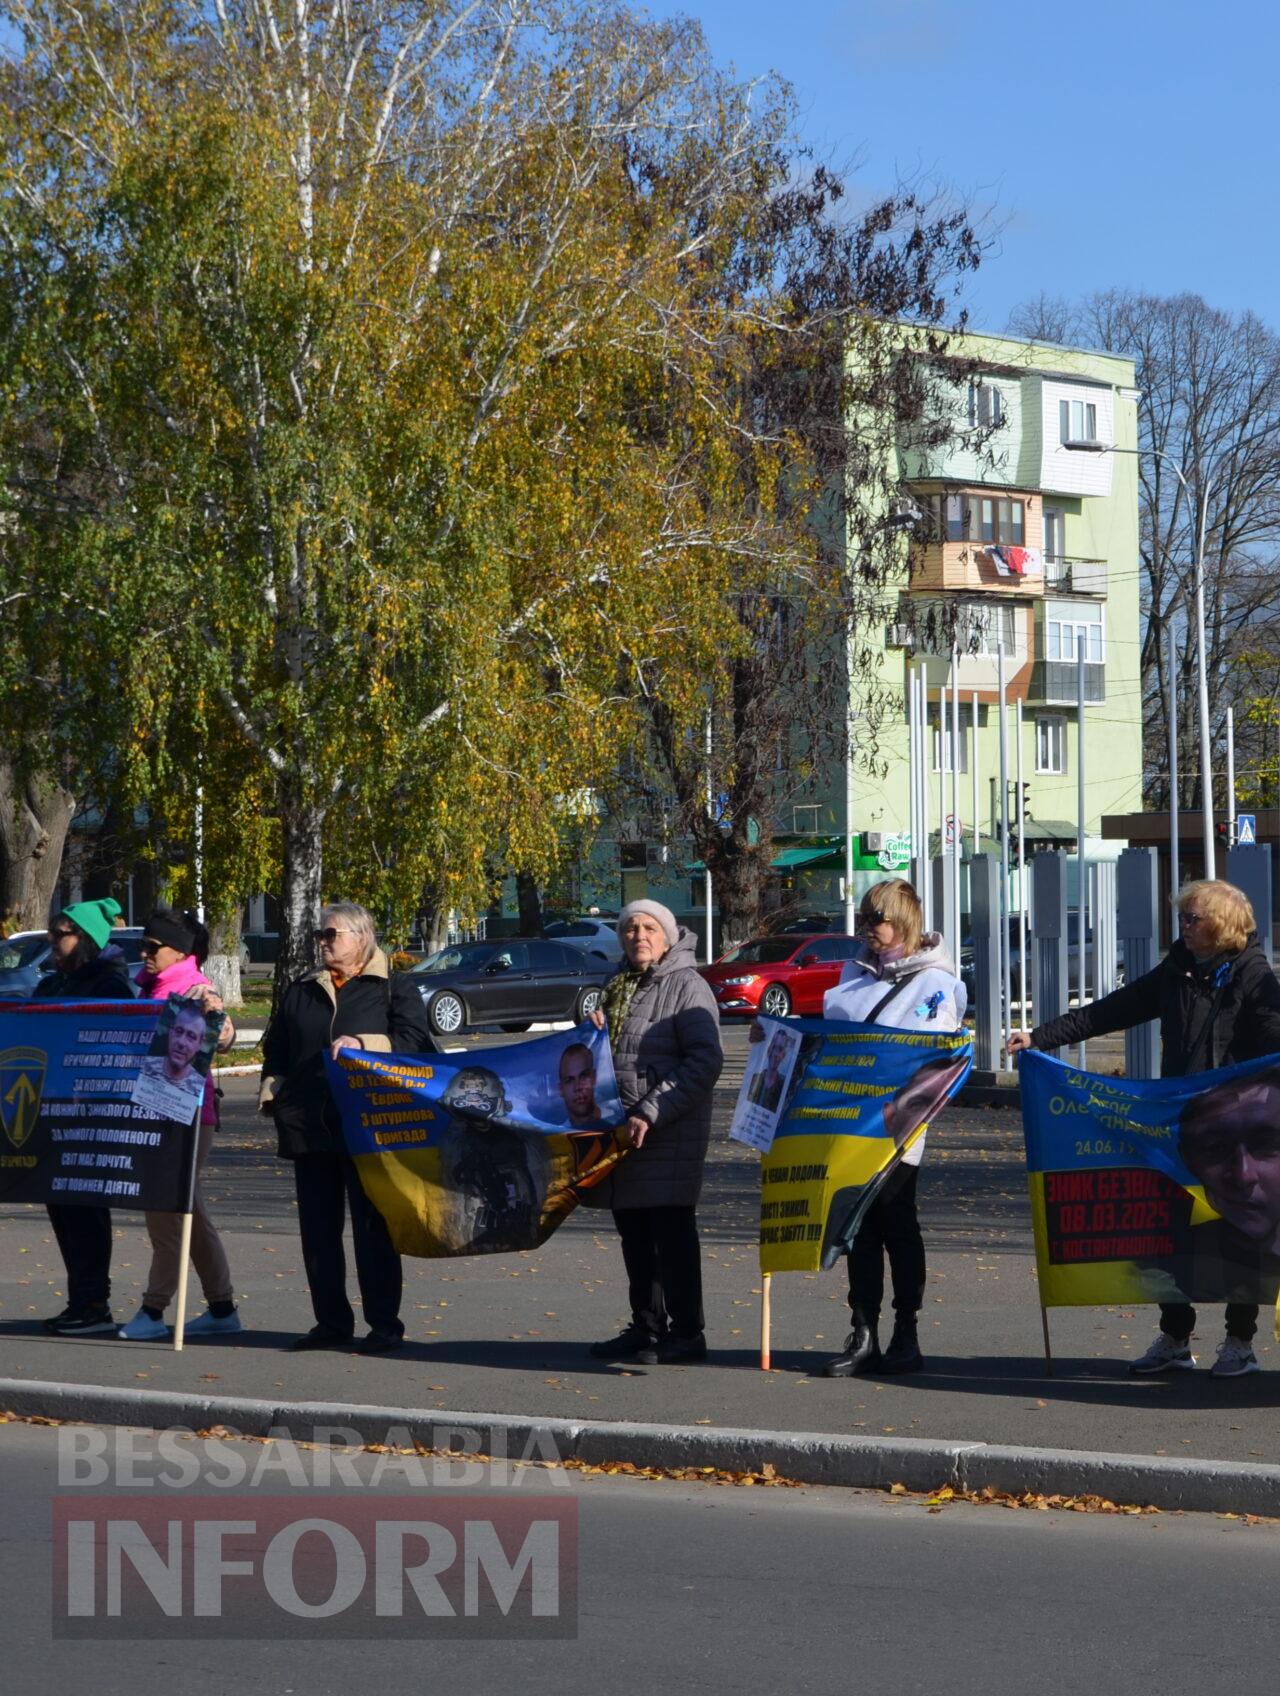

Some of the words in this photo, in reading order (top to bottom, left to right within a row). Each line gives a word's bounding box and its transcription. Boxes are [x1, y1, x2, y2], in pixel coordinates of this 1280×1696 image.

[371, 1109, 436, 1126] штурмова
[96, 1129, 161, 1146] ПОЛОНЕНОГО!
[104, 1180, 141, 1196] ДІЯТИ!
[1047, 1173, 1094, 1203] ЗНИК
[1060, 1202, 1169, 1233] 08.03.2025
